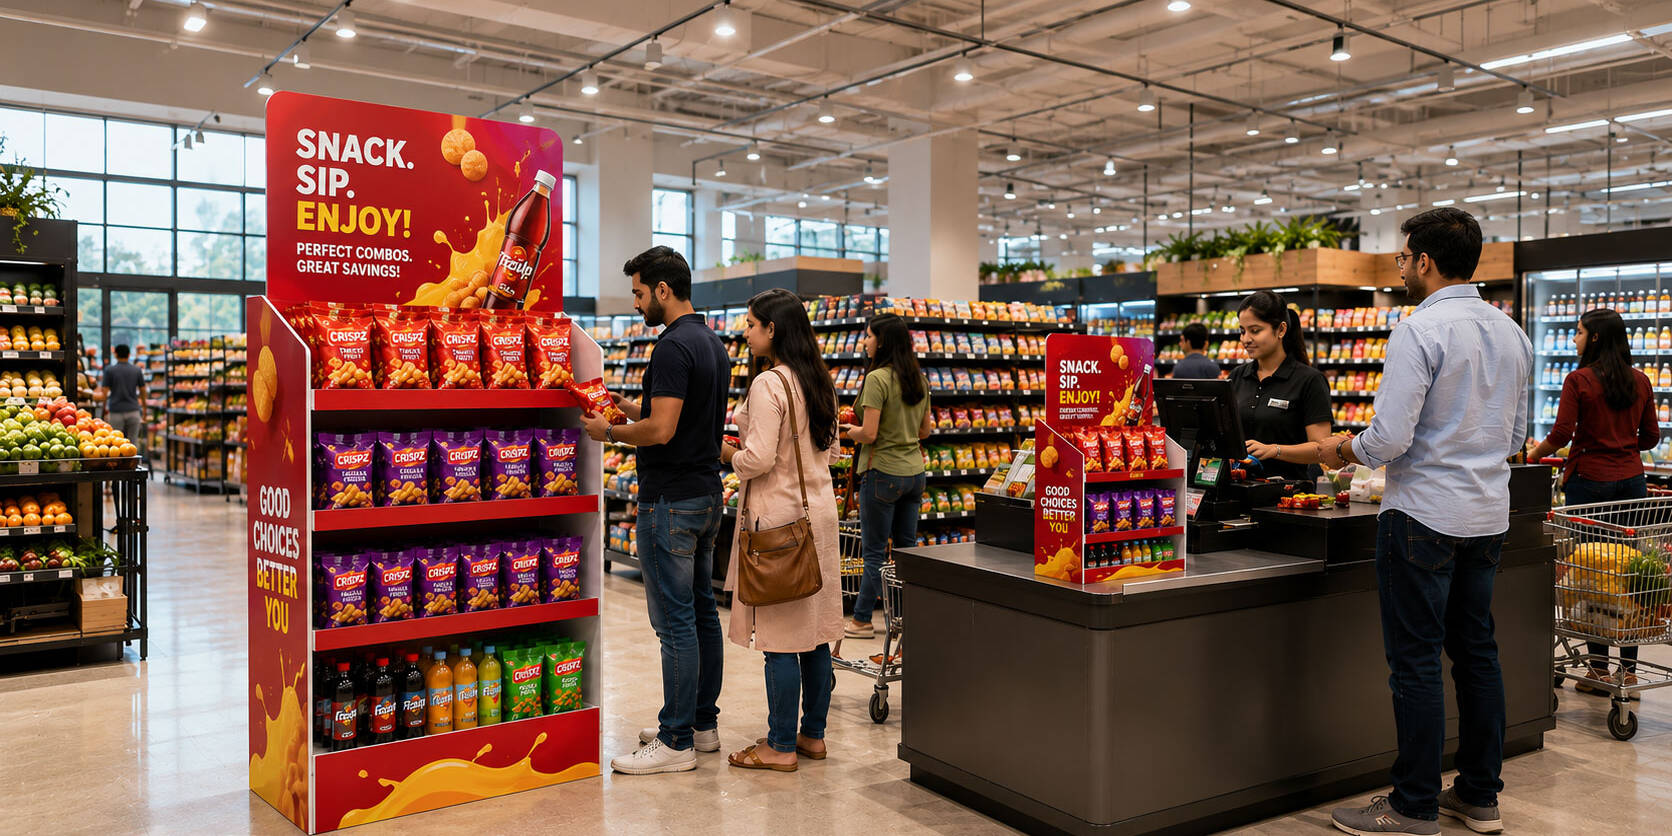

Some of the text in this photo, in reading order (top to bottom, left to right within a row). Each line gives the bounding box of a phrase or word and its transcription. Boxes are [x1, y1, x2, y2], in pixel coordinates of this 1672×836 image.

[296, 128, 414, 170] SNACK.
[296, 164, 355, 199] SIP.
[296, 200, 412, 239] ENJOY!
[296, 242, 413, 263] PERFECT COMBOS.
[296, 259, 401, 278] GREAT SAVINGS!
[330, 331, 368, 342] CRISPZ
[392, 332, 425, 343] CRISPZ
[1059, 359, 1102, 374] SNACK.
[1059, 374, 1081, 389] SIP.
[1059, 390, 1100, 404] ENJOY!
[337, 453, 369, 465] CRISPZ
[394, 451, 425, 463] CRISPZ
[1045, 485, 1070, 497] GOOD
[259, 484, 290, 519] GOOD
[1040, 497, 1077, 509] CHOICES
[1042, 508, 1076, 521] BETTER
[1049, 521, 1069, 534] YOU
[253, 520, 300, 560] CHOICES
[256, 557, 298, 600] BETTER
[265, 595, 289, 635] YOU
